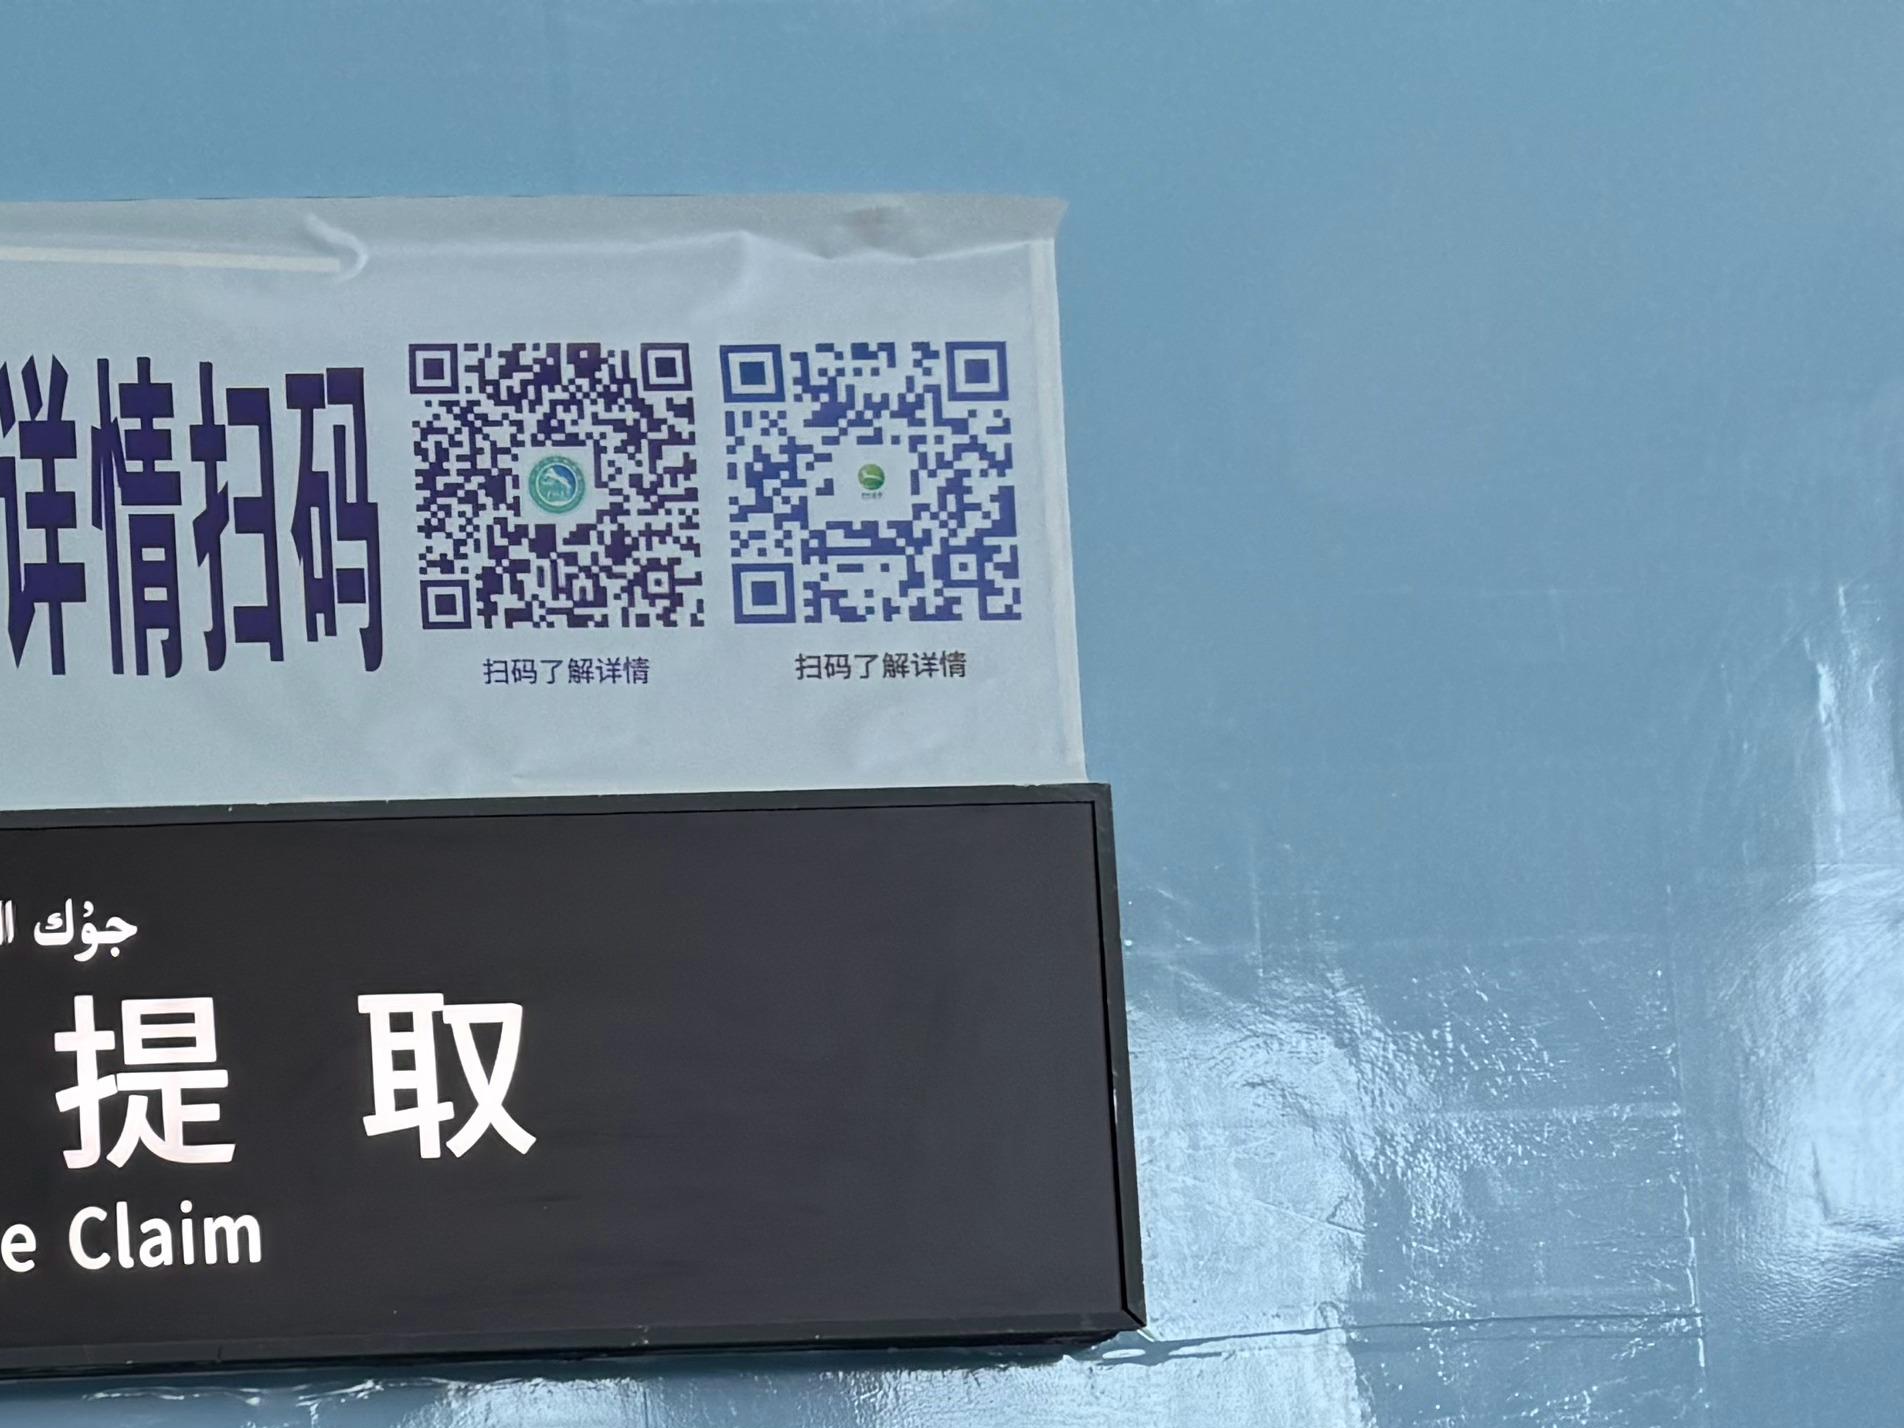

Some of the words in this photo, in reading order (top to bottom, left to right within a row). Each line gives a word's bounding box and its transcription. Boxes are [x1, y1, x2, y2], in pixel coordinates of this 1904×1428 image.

[483, 657, 651, 686] 扫码了解详情
[794, 651, 967, 680] 扫码了解详情
[68, 1200, 263, 1270] Claim
